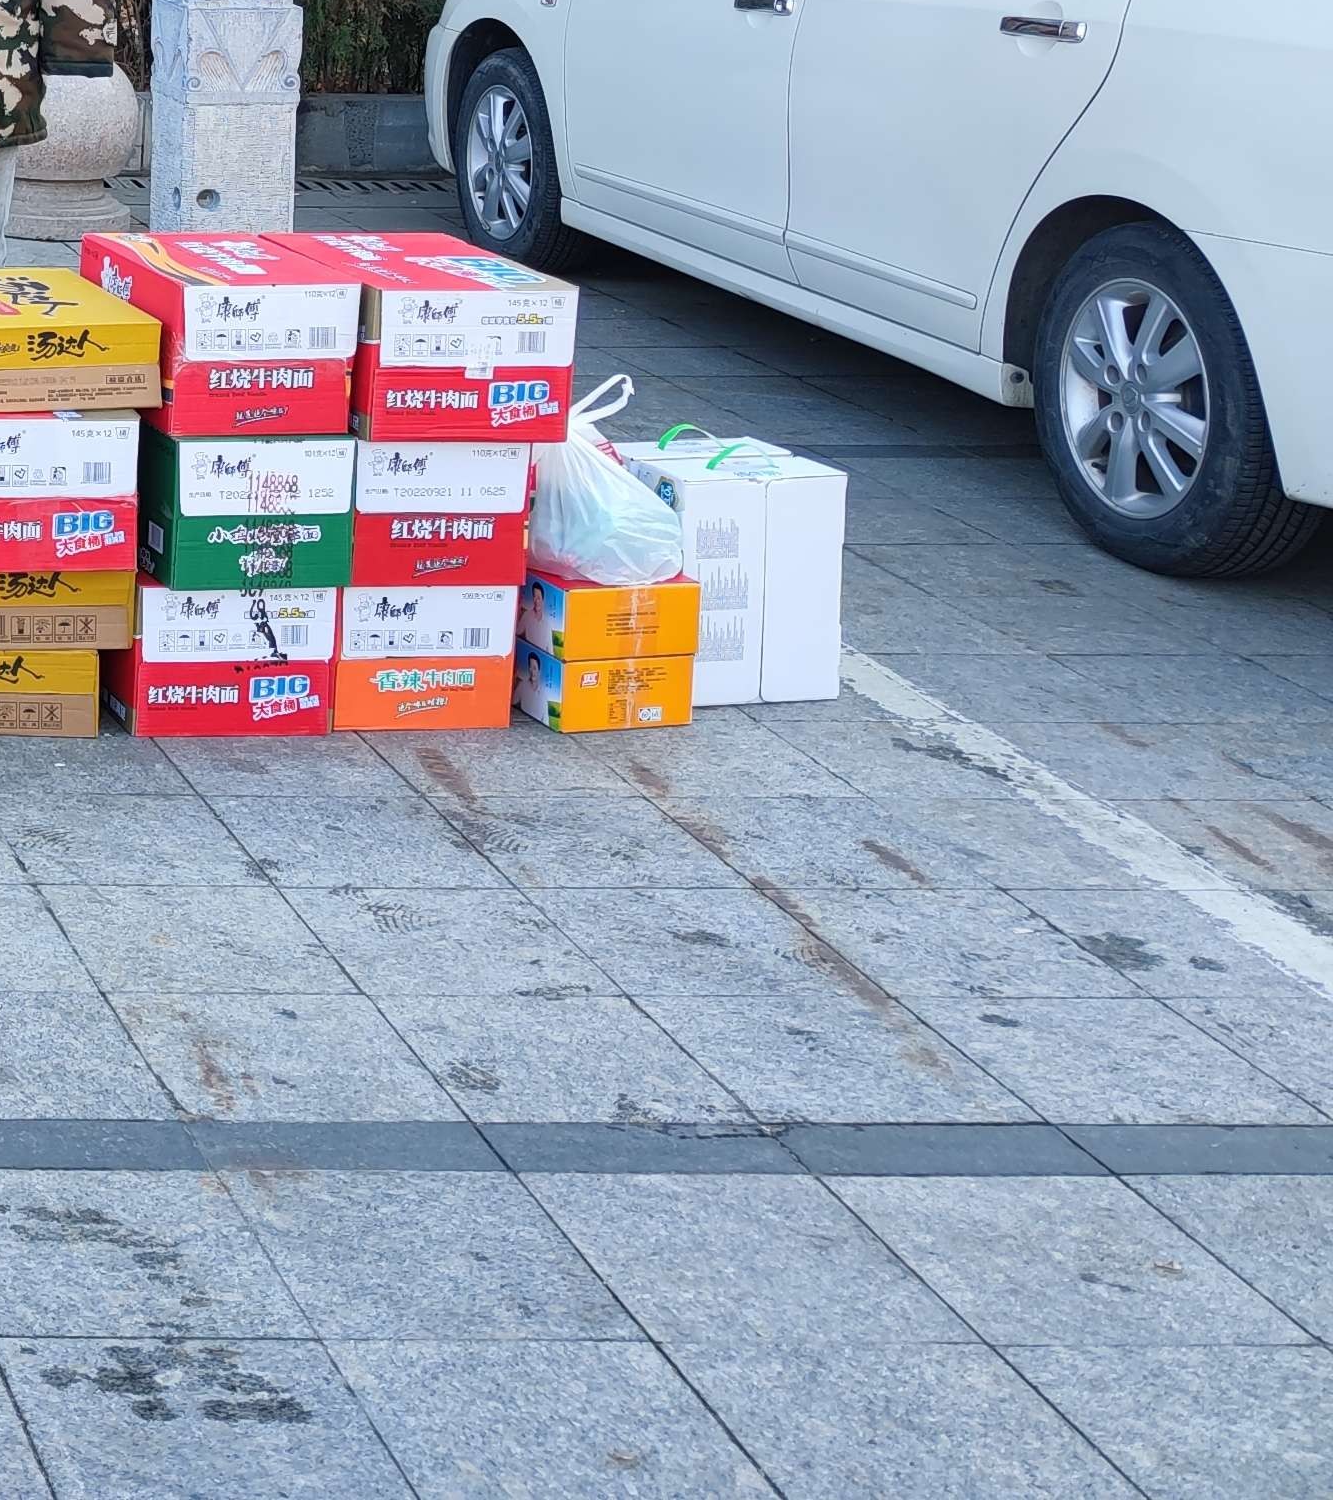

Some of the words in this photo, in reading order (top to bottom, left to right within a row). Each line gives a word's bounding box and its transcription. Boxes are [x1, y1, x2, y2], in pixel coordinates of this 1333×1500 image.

[27, 330, 110, 361] 汤达人
[209, 368, 314, 389] 红烧牛肉面
[386, 389, 478, 408] 红烧牛肉面
[492, 382, 549, 405] BIG
[308, 488, 334, 498] 1252
[460, 487, 472, 497] 11
[54, 512, 113, 537] BIG
[391, 517, 495, 539] 红烧牛肉面
[148, 685, 239, 704] 红烧牛肉面
[252, 676, 308, 699] BIG
[376, 669, 475, 692] 香辣牛肉面
